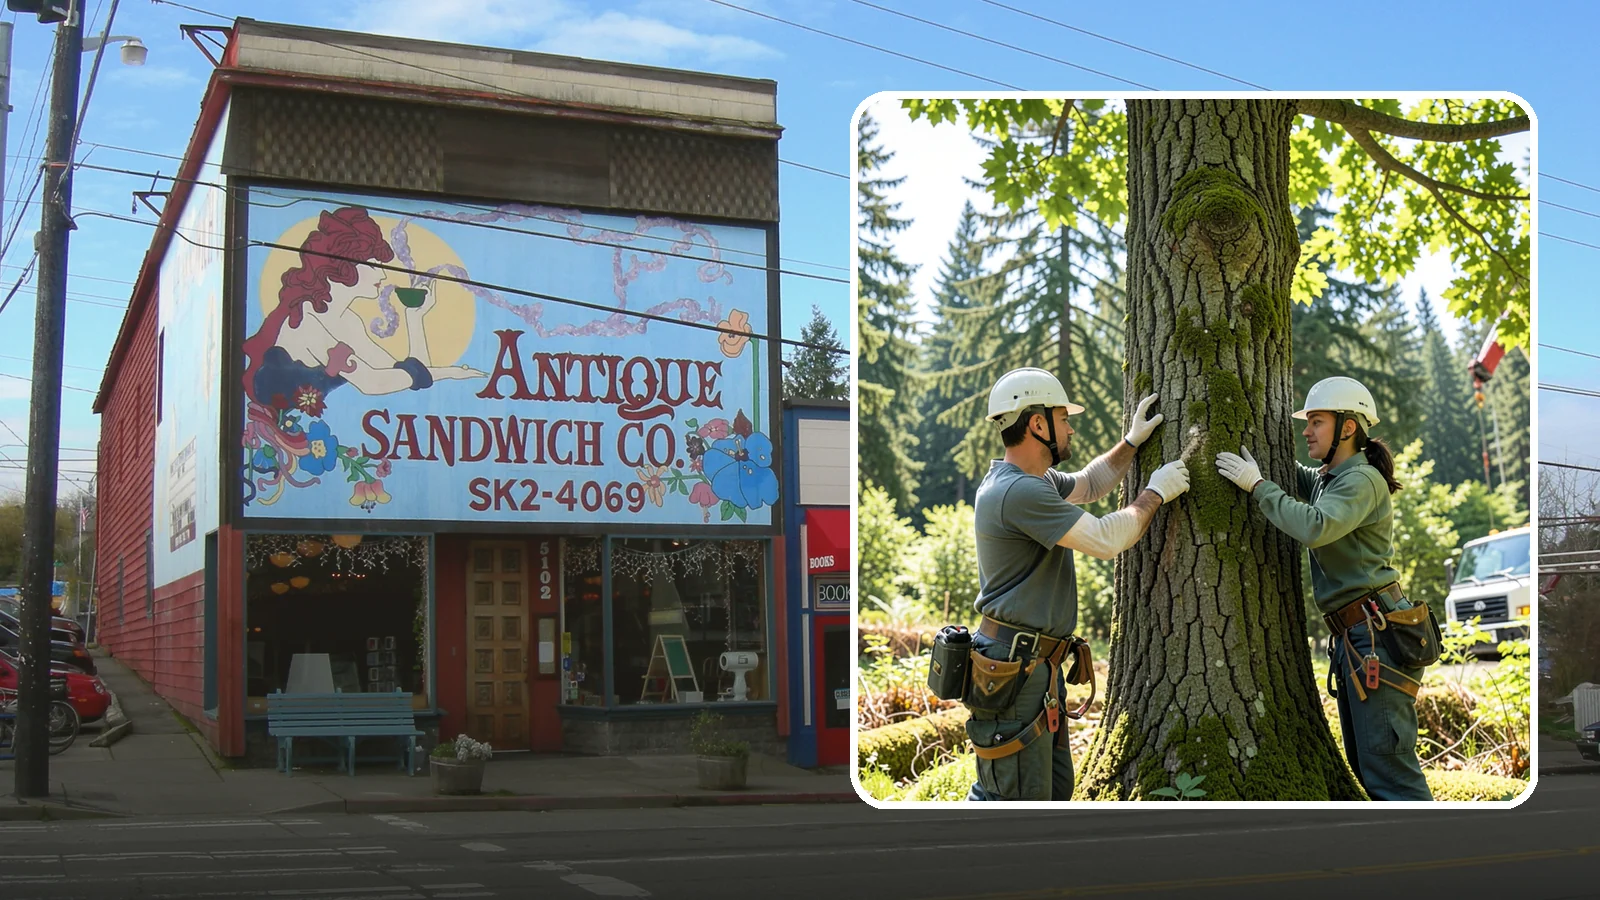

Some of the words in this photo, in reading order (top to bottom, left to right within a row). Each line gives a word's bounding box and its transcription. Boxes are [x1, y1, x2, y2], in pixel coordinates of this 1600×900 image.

[476, 329, 723, 420] ANTIQUE
[361, 409, 604, 467] SANDWICH
[617, 422, 685, 468] CO.
[469, 477, 646, 512] SK2-4069
[539, 542, 551, 600] 5102
[809, 555, 835, 569] BOOKS
